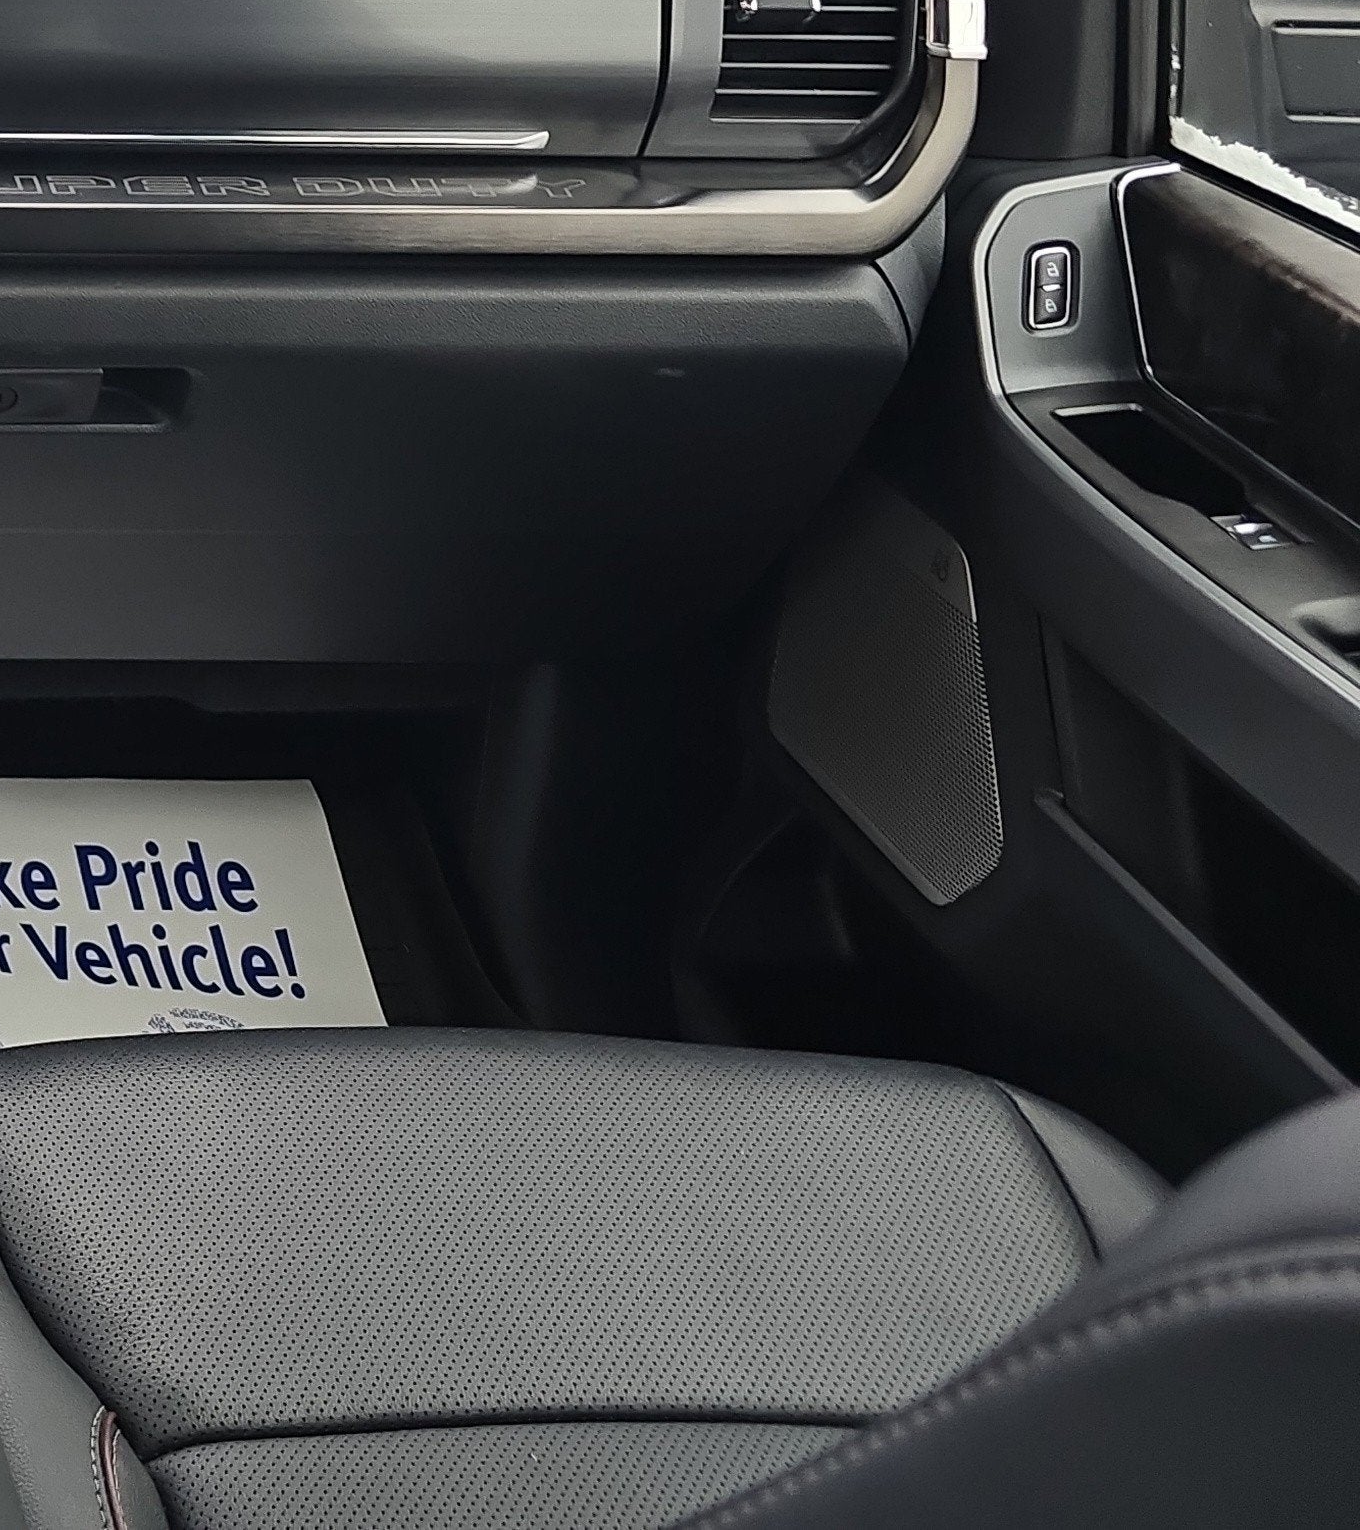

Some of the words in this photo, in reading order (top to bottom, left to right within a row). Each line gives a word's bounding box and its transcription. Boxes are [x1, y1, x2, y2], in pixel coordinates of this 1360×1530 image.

[292, 175, 586, 199] DUTY
[75, 840, 258, 913] Pride
[21, 923, 308, 1000] Vehicle!
